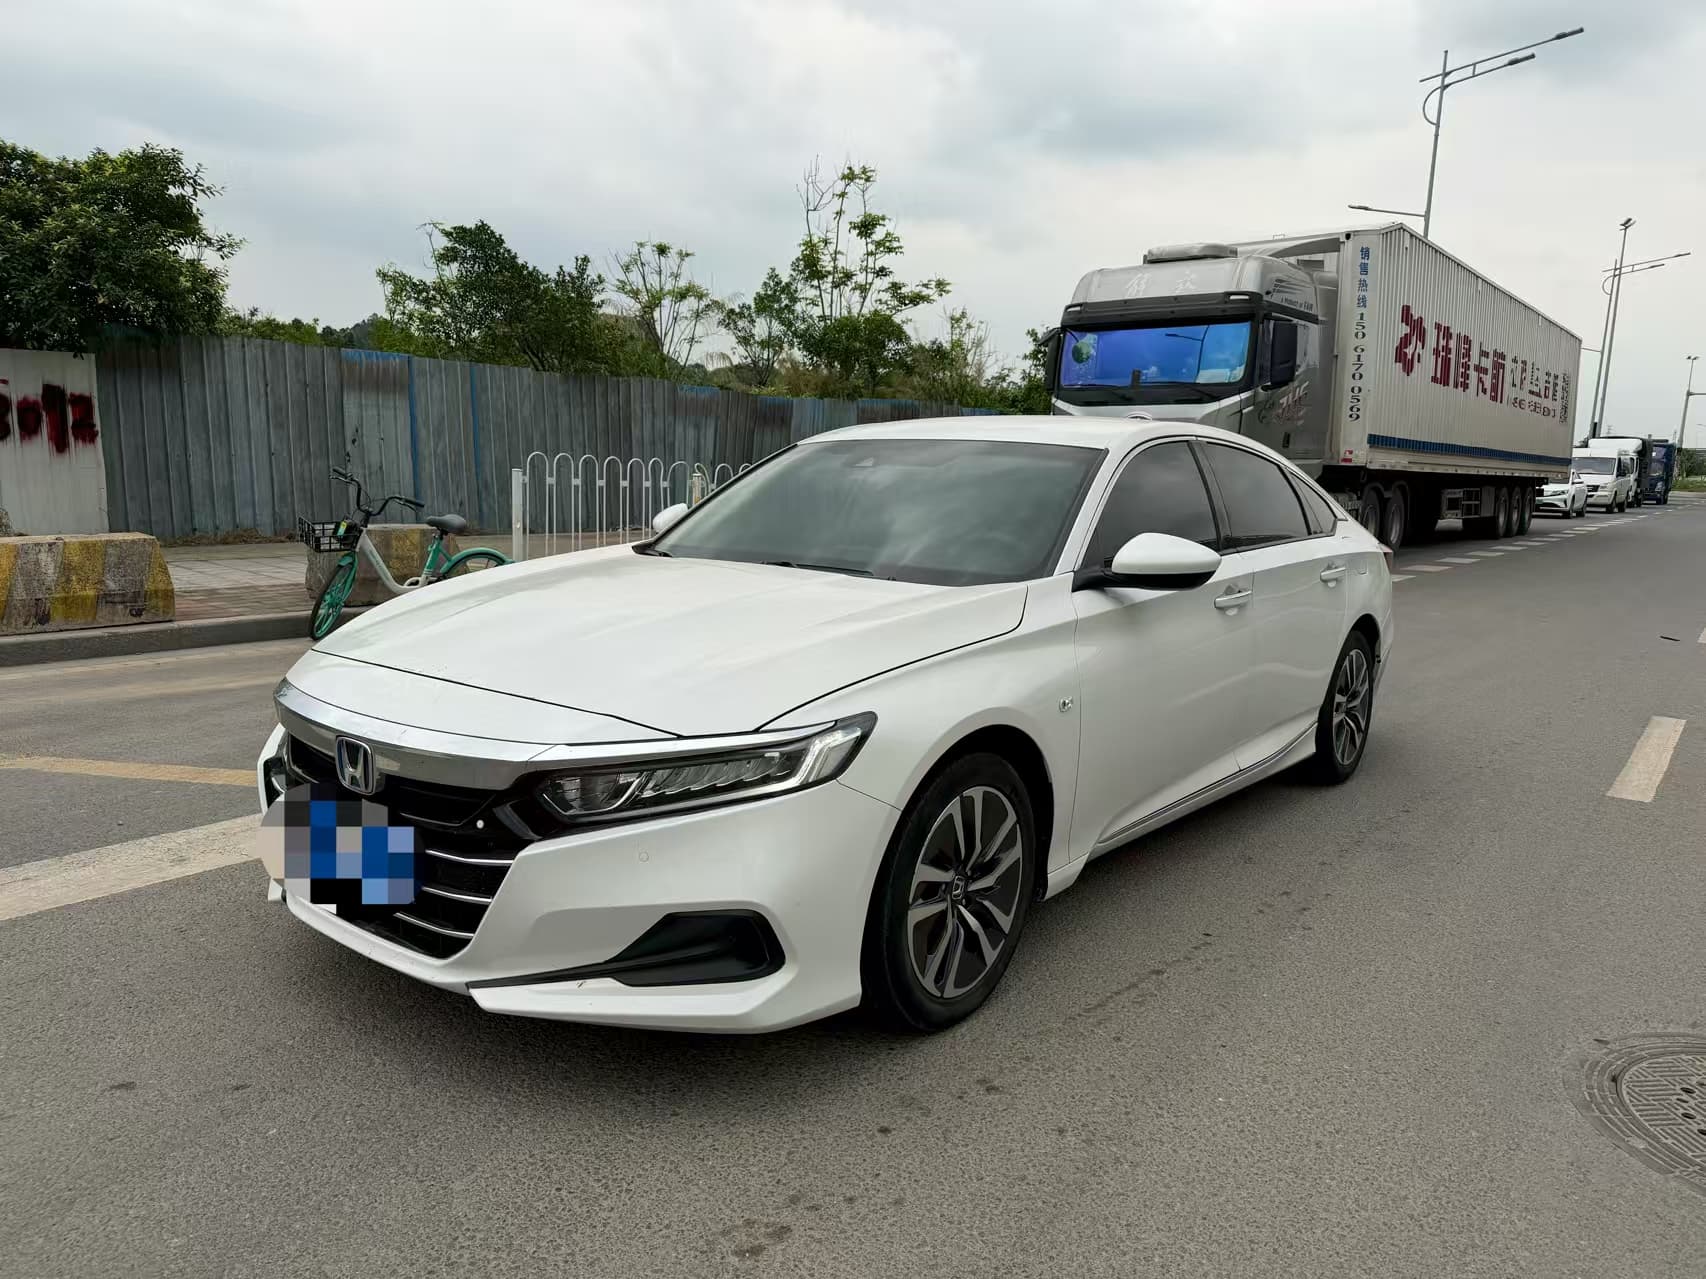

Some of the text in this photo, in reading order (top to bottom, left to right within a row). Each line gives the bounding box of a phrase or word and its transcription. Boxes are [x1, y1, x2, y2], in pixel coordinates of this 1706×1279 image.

[1356, 246, 1370, 309] 销售热线
[1348, 312, 1367, 422] 150 6170 0569
